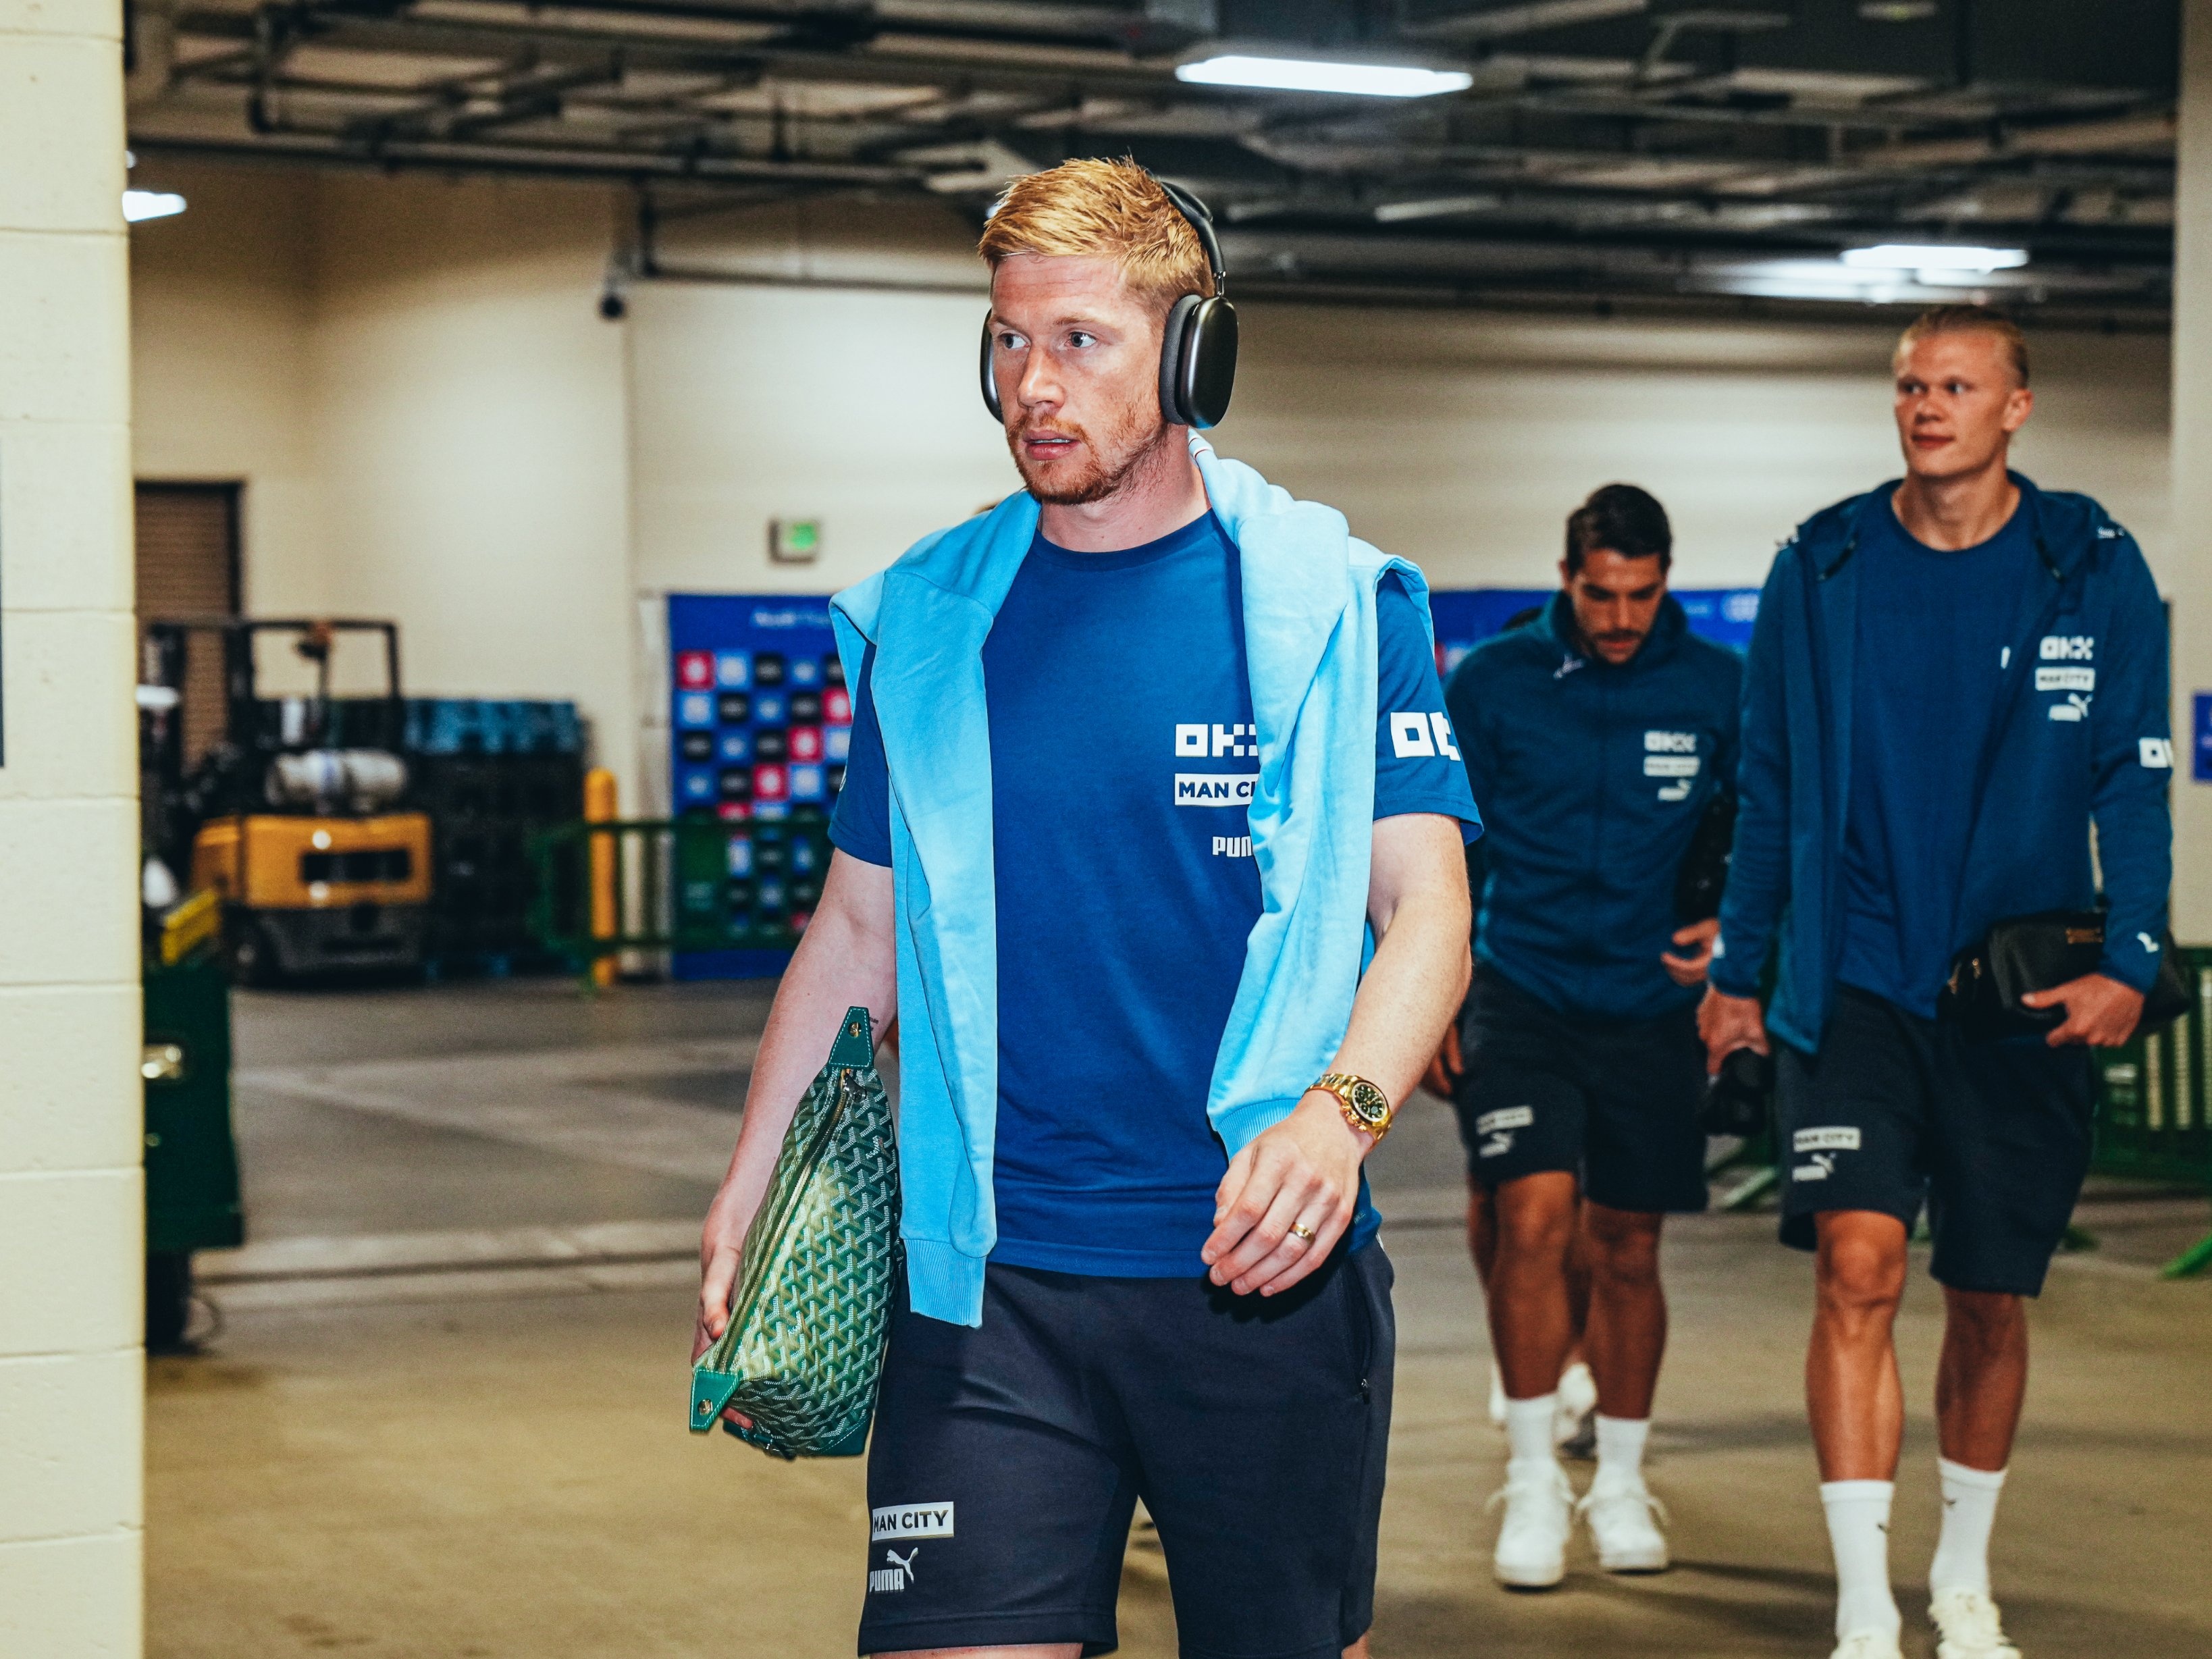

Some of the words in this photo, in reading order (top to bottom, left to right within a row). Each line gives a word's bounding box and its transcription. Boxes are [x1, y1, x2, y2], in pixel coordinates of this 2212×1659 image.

[1176, 724, 1259, 758] OK
[1179, 781, 1229, 798] MAN
[1236, 781, 1257, 798] CI
[873, 1514, 897, 1533] MAN
[902, 1510, 949, 1529] CITY
[869, 1568, 905, 1593] PUMA
